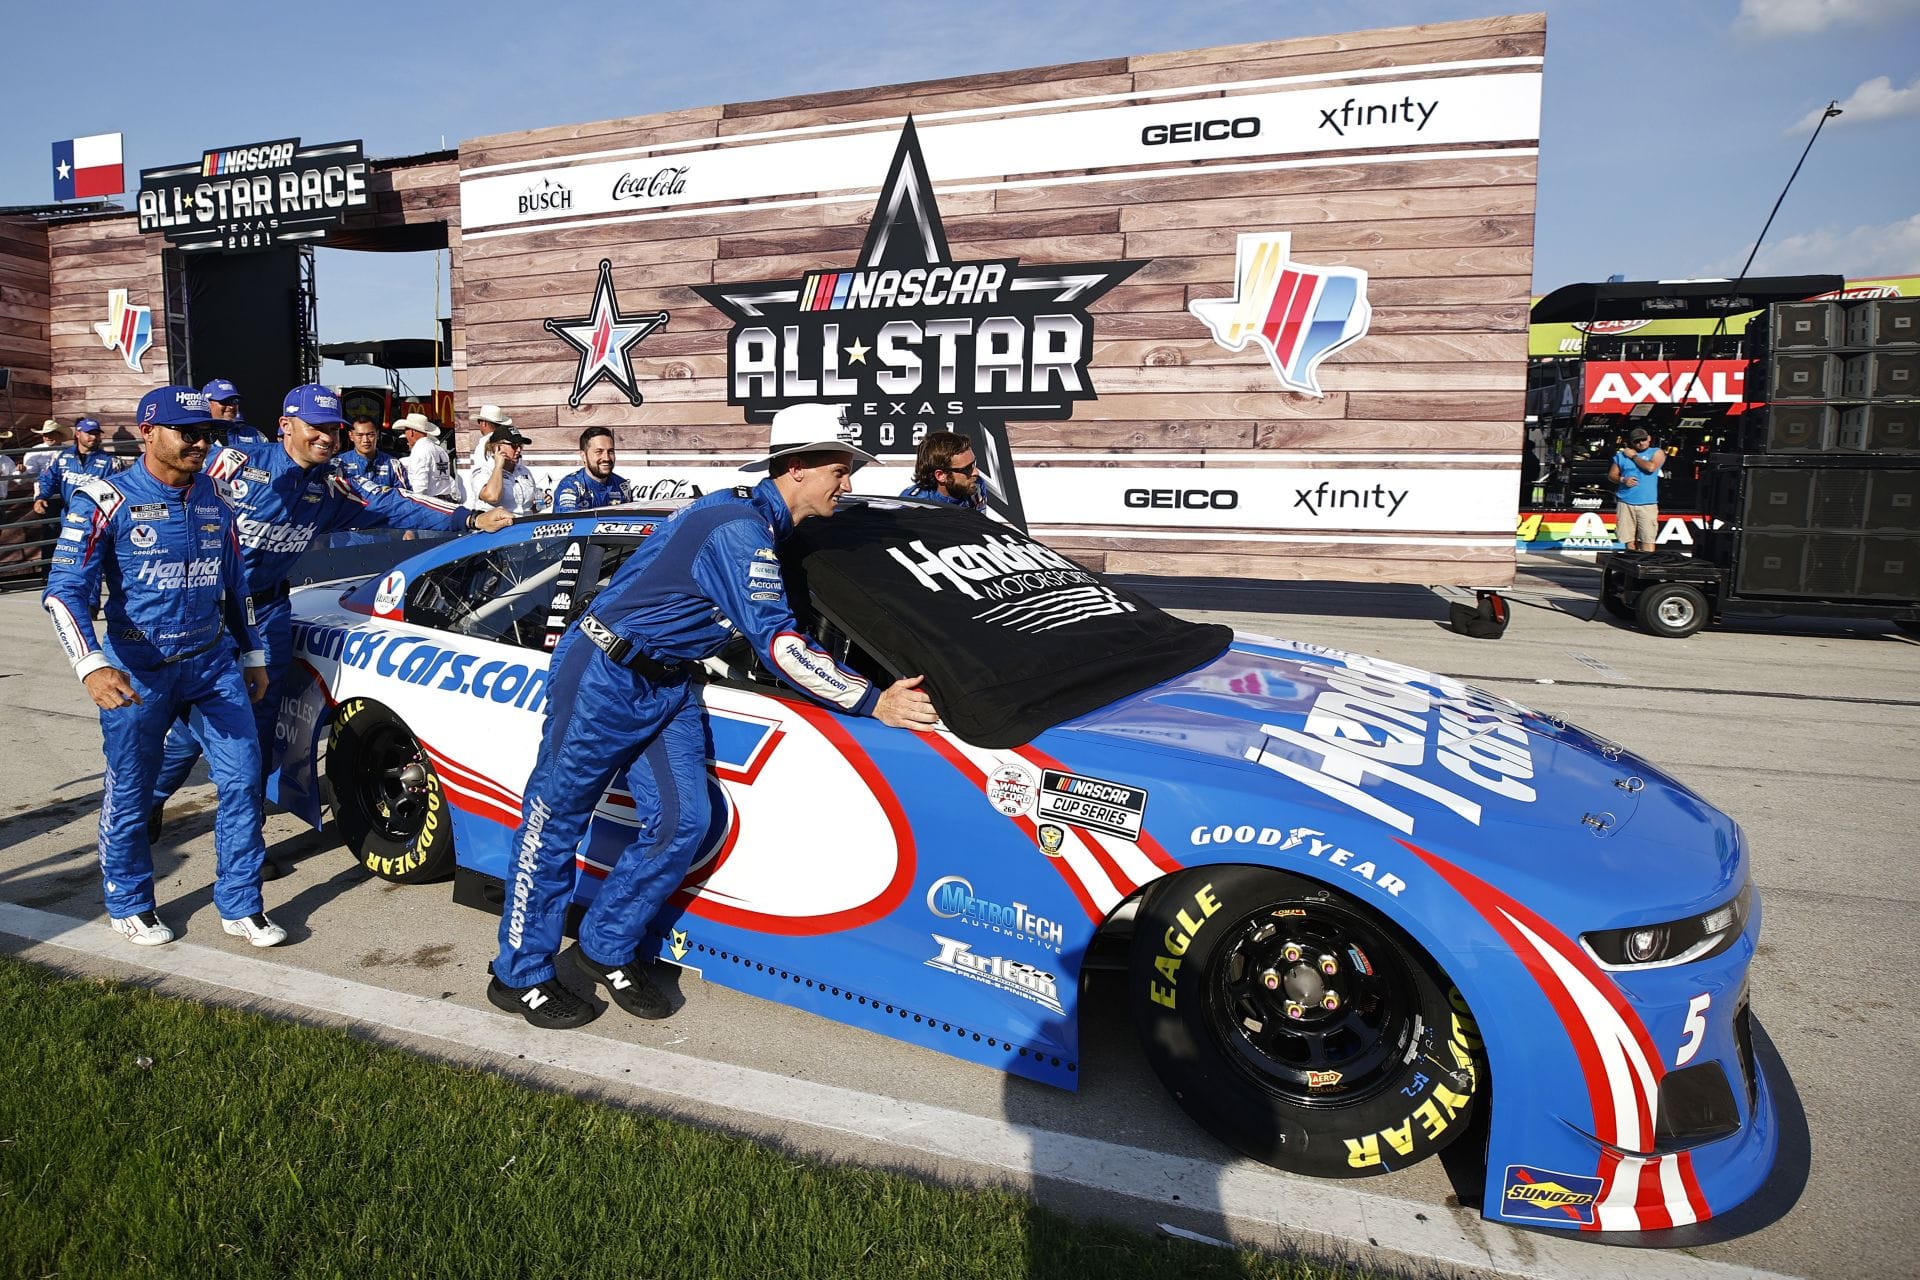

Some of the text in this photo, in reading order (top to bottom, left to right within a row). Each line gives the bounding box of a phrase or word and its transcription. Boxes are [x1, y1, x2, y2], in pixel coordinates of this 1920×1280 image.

[1318, 95, 1439, 136] xfinity
[1141, 116, 1262, 147] GEICO
[224, 142, 294, 175] NASCAR
[279, 163, 367, 214] RACE
[611, 165, 691, 201] Coca-Cola
[518, 188, 572, 214] BUSCH
[217, 219, 279, 233] TEXAS
[228, 232, 271, 249] 2021
[851, 264, 1007, 309] NASCAR
[734, 313, 1084, 398] ALL STAR
[1590, 372, 1744, 403] AXAL
[1124, 488, 1238, 510] GEICO
[1293, 481, 1409, 517] xfinity
[1562, 538, 1614, 547] AXALTA
[137, 556, 222, 586] Hendrick
[157, 574, 217, 590] cars.com
[279, 696, 314, 725] ICLES
[328, 698, 365, 751] EAGLE
[275, 721, 299, 745] OW
[991, 788, 1033, 804] RECORD
[999, 781, 1027, 794] WINS
[1073, 779, 1131, 805] NASCAR
[1003, 805, 1017, 814] 269
[1053, 797, 1128, 826] CUP SERIES
[941, 883, 1064, 946] METROTECH
[961, 917, 1062, 955] AUTOMOTIVE
[1150, 883, 1223, 1010] EAGLE
[605, 969, 632, 991] N
[521, 987, 549, 1010] N
[1676, 992, 1711, 1067] 5
[1312, 1073, 1337, 1083] AERO
[1509, 1184, 1592, 1205] SUNOCO
